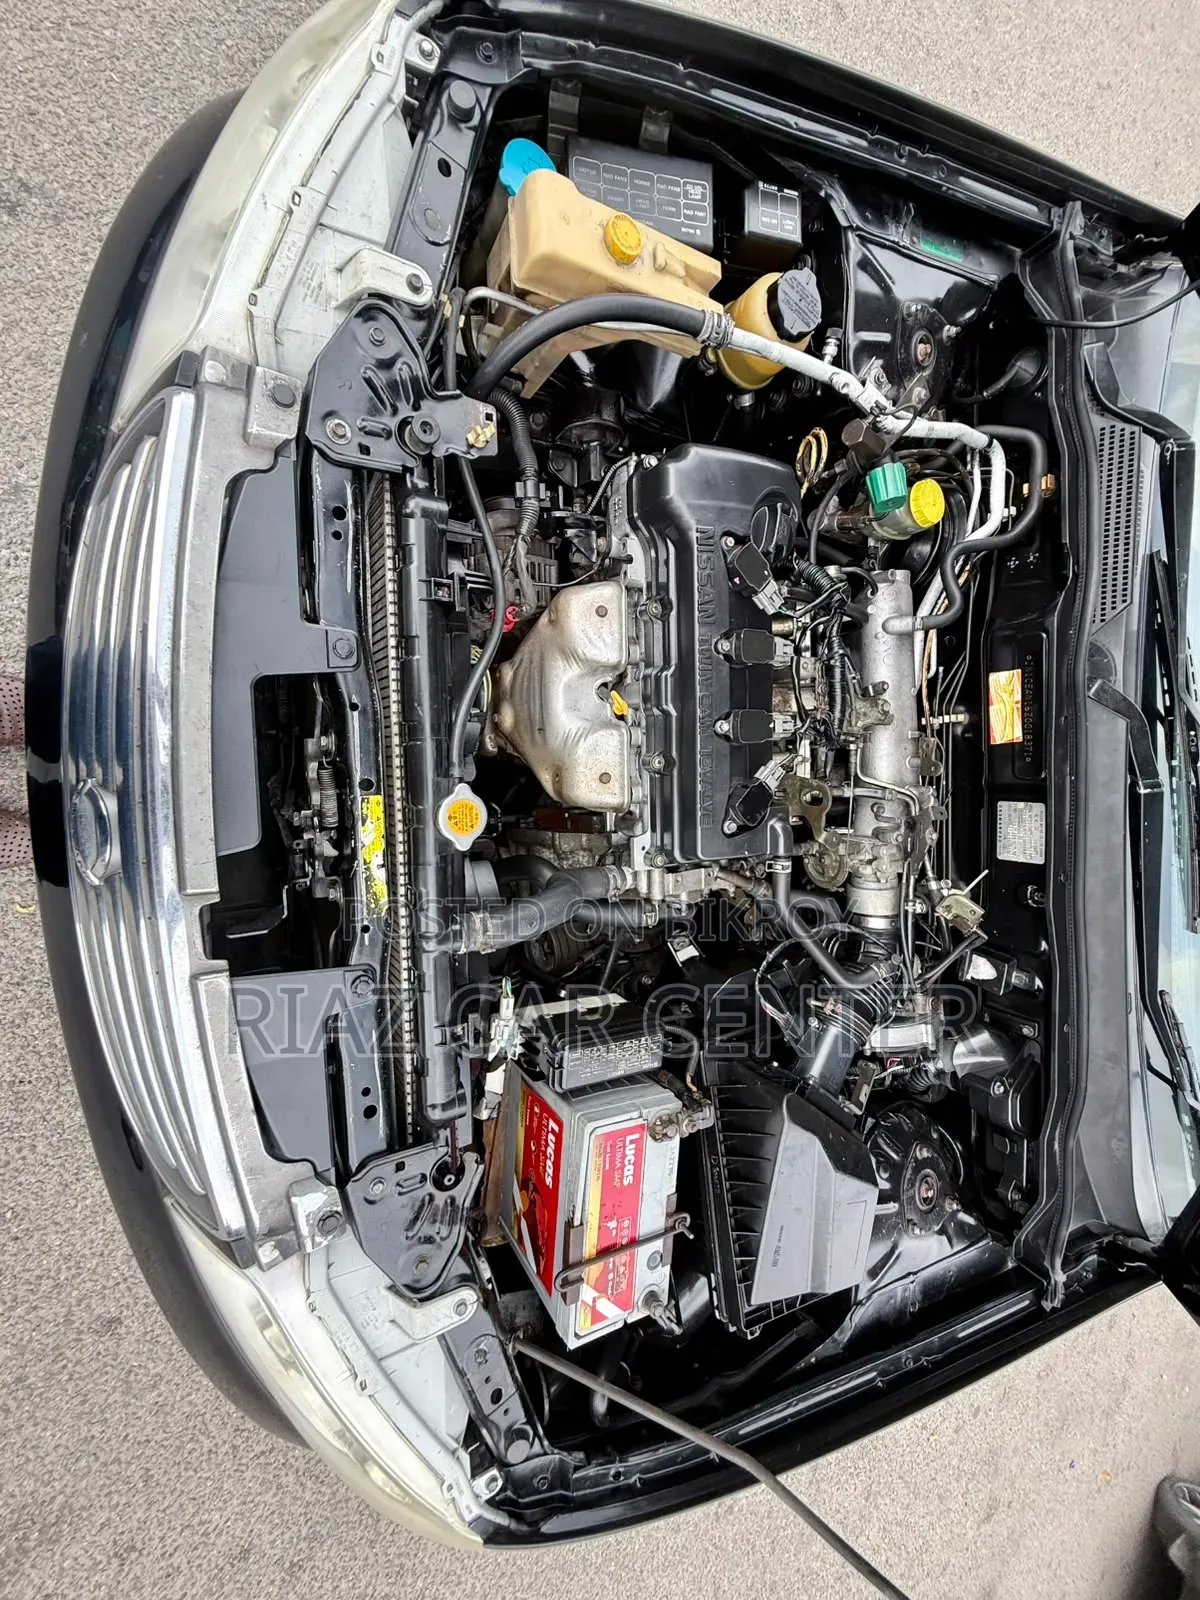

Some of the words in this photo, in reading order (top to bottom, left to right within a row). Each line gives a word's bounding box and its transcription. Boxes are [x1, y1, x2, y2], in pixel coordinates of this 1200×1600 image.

[696, 526, 716, 625] NISSAN
[698, 633, 712, 685] TWIN
[699, 692, 713, 736] CAM
[539, 1112, 549, 1151] ULTIMA
[544, 1117, 560, 1188] Lucas
[614, 1137, 624, 1169] ULTIMA
[613, 1169, 622, 1188] SMF
[622, 1133, 640, 1186] Lucas
